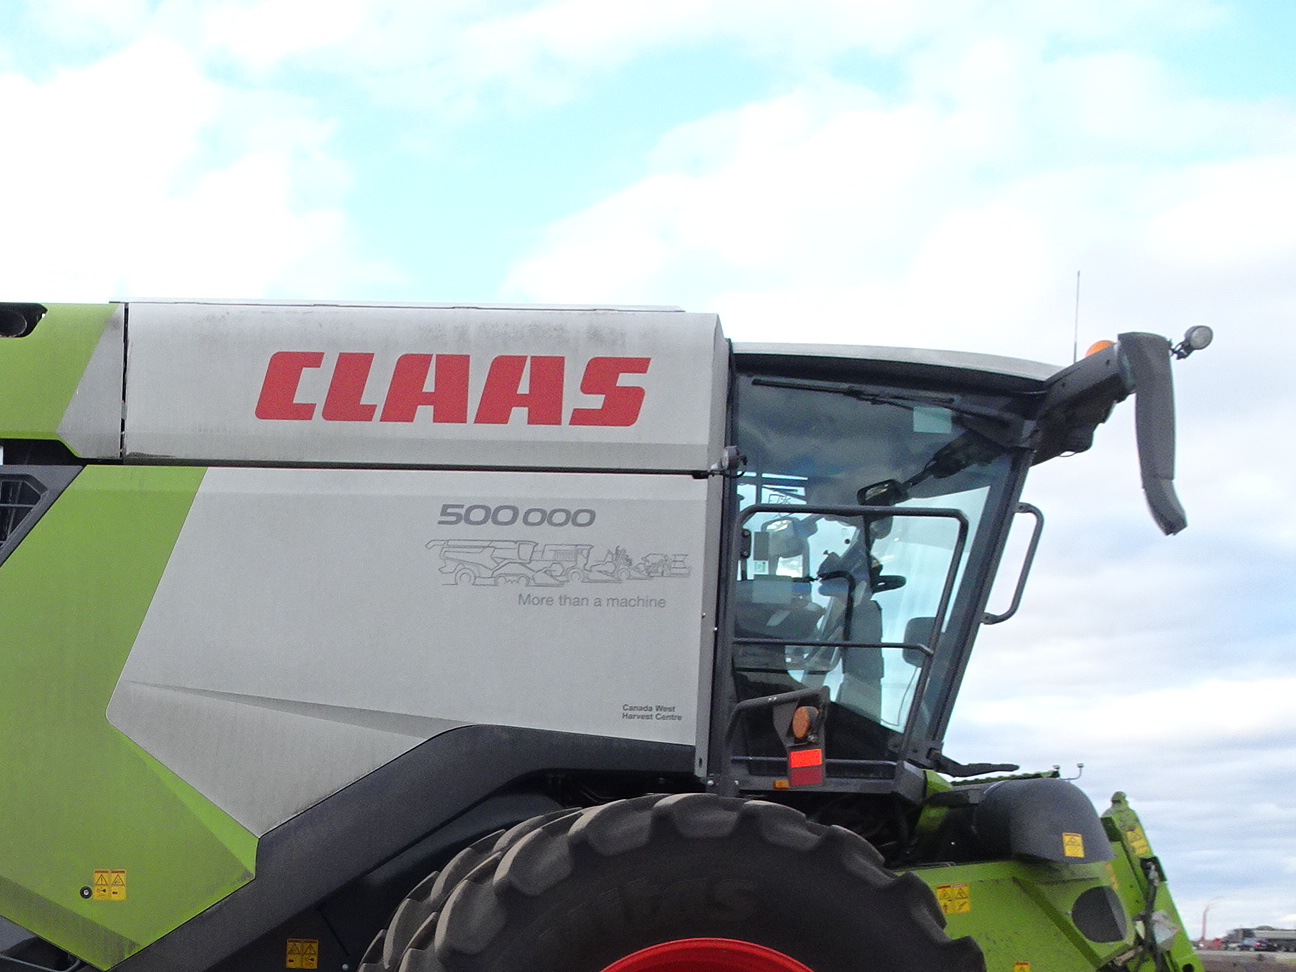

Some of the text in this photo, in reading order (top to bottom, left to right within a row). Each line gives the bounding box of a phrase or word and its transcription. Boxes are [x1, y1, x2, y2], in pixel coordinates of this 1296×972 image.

[255, 351, 651, 426] CLAAS
[438, 504, 596, 527] 500 000
[518, 594, 666, 608] More than a machine
[622, 704, 652, 712] Canada
[622, 712, 682, 721] Harvest Centre
